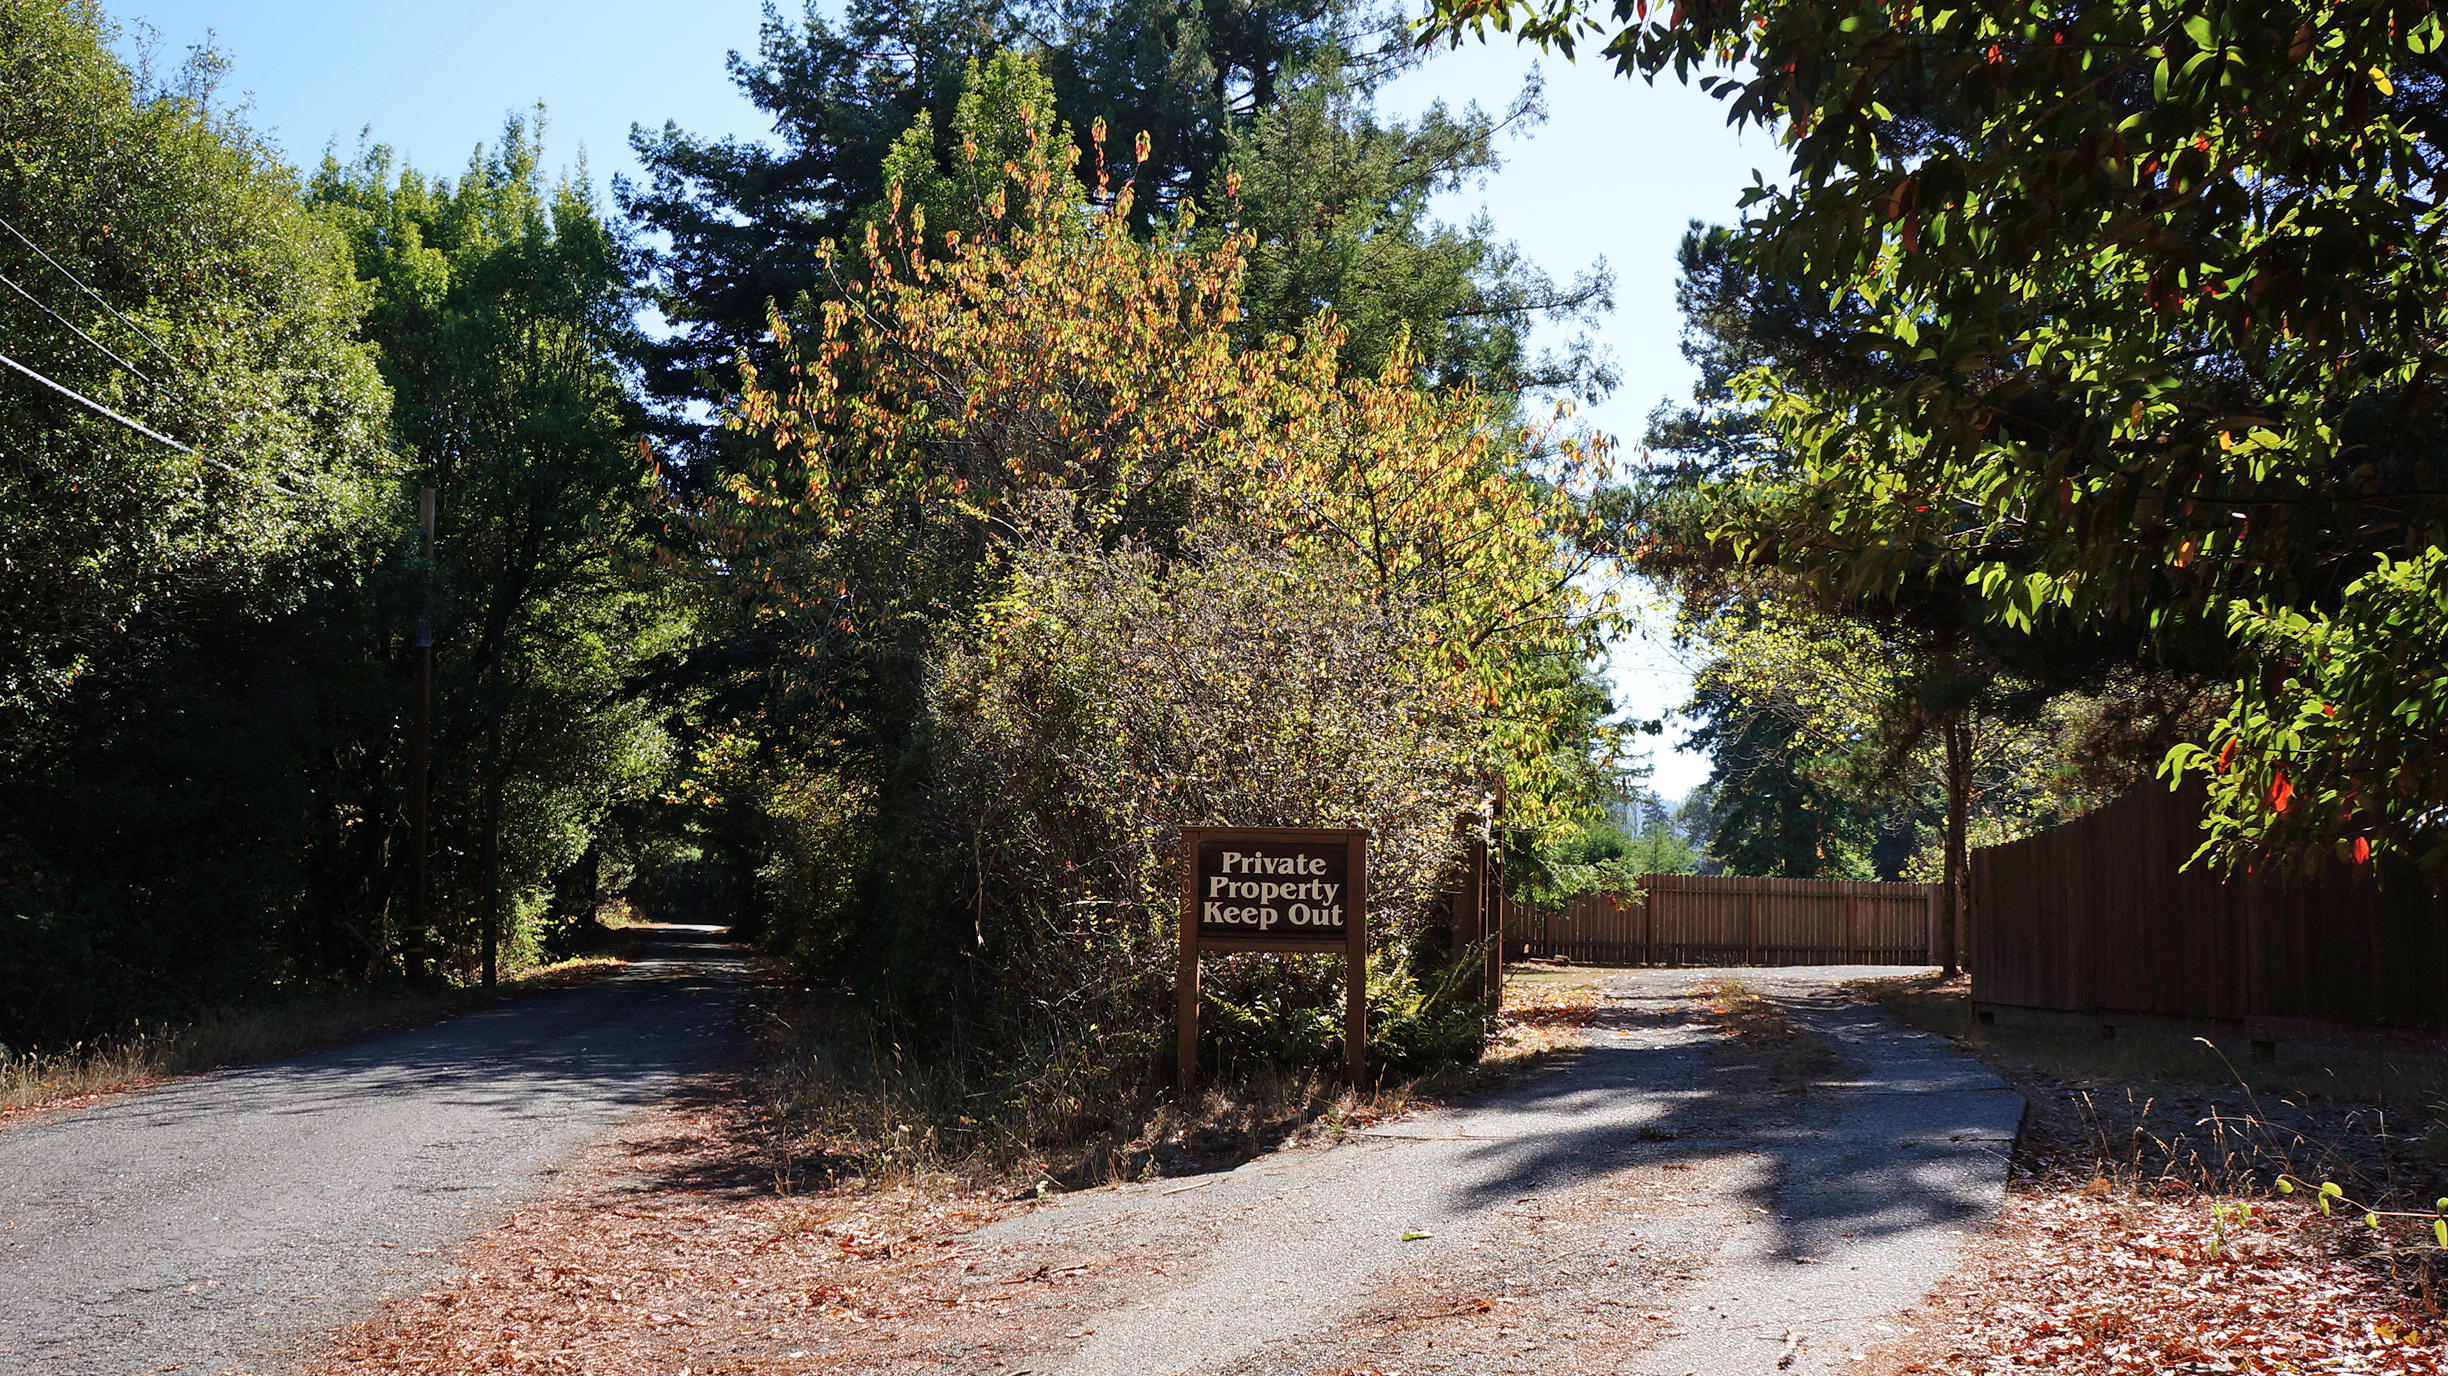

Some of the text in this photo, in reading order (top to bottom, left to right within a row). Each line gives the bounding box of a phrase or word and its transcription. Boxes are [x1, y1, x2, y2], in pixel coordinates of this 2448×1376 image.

[1222, 851, 1327, 875] Private
[1182, 842, 1192, 914] 3502
[1209, 876, 1340, 907] Property
[1203, 902, 1344, 930] Keep Out
